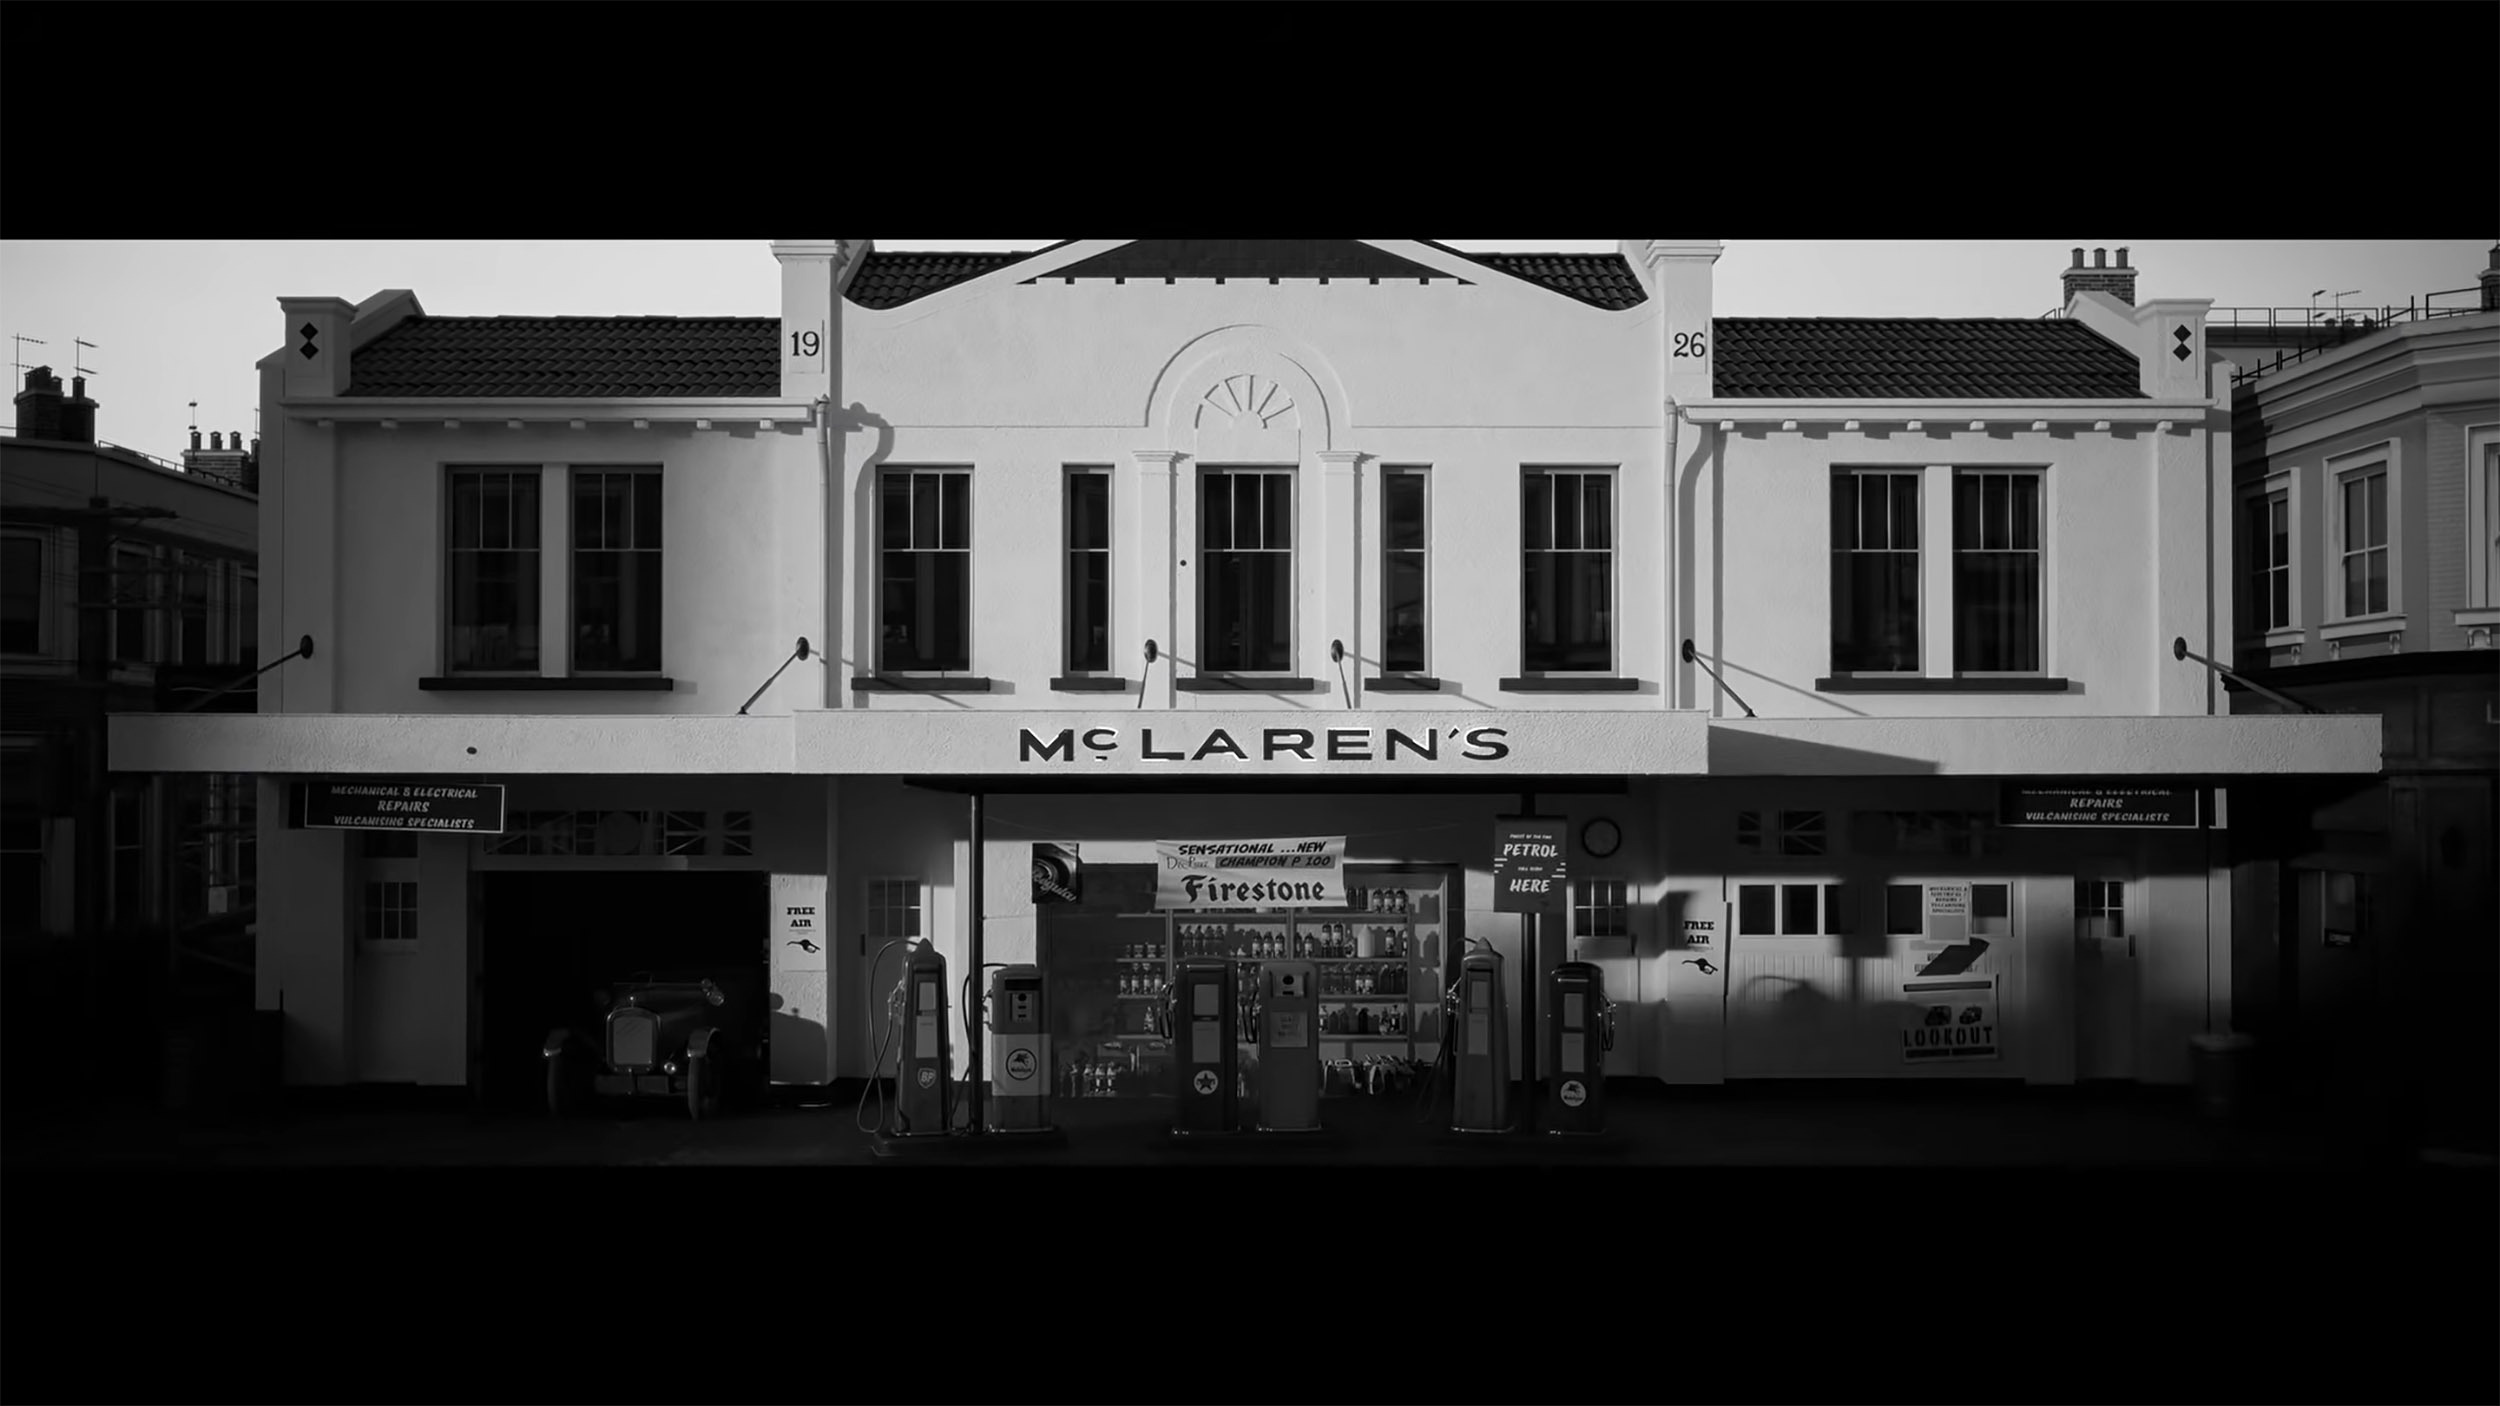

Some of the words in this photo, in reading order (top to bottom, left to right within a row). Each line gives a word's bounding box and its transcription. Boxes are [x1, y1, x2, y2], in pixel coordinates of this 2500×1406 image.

[791, 331, 820, 357] 19
[1674, 332, 1705, 357] 26
[330, 785, 400, 796] MECHANICAL
[413, 786, 478, 799] ELECTRICAL
[377, 800, 430, 813] REPAIRS
[2069, 798, 2124, 809] REPAIRS
[333, 815, 404, 827] VULCANISING
[407, 817, 475, 829] SPECIALISTS
[2025, 812, 2098, 821] VULCANISING
[2101, 812, 2171, 822] SPECIALISTS
[1178, 843, 1274, 855] SENSATIONAL
[1503, 843, 1559, 858] PETROL
[1220, 856, 1287, 867] CHAMPION
[1292, 857, 1301, 867] P
[1307, 856, 1331, 866] 100
[1181, 875, 1325, 903] Firestone
[1509, 878, 1551, 893] HERE
[787, 907, 816, 915] FREE
[790, 919, 812, 927] AIR
[1684, 920, 1714, 930] FREE
[1687, 934, 1710, 944] AIR
[1904, 1026, 1993, 1048] LOOKOUT
